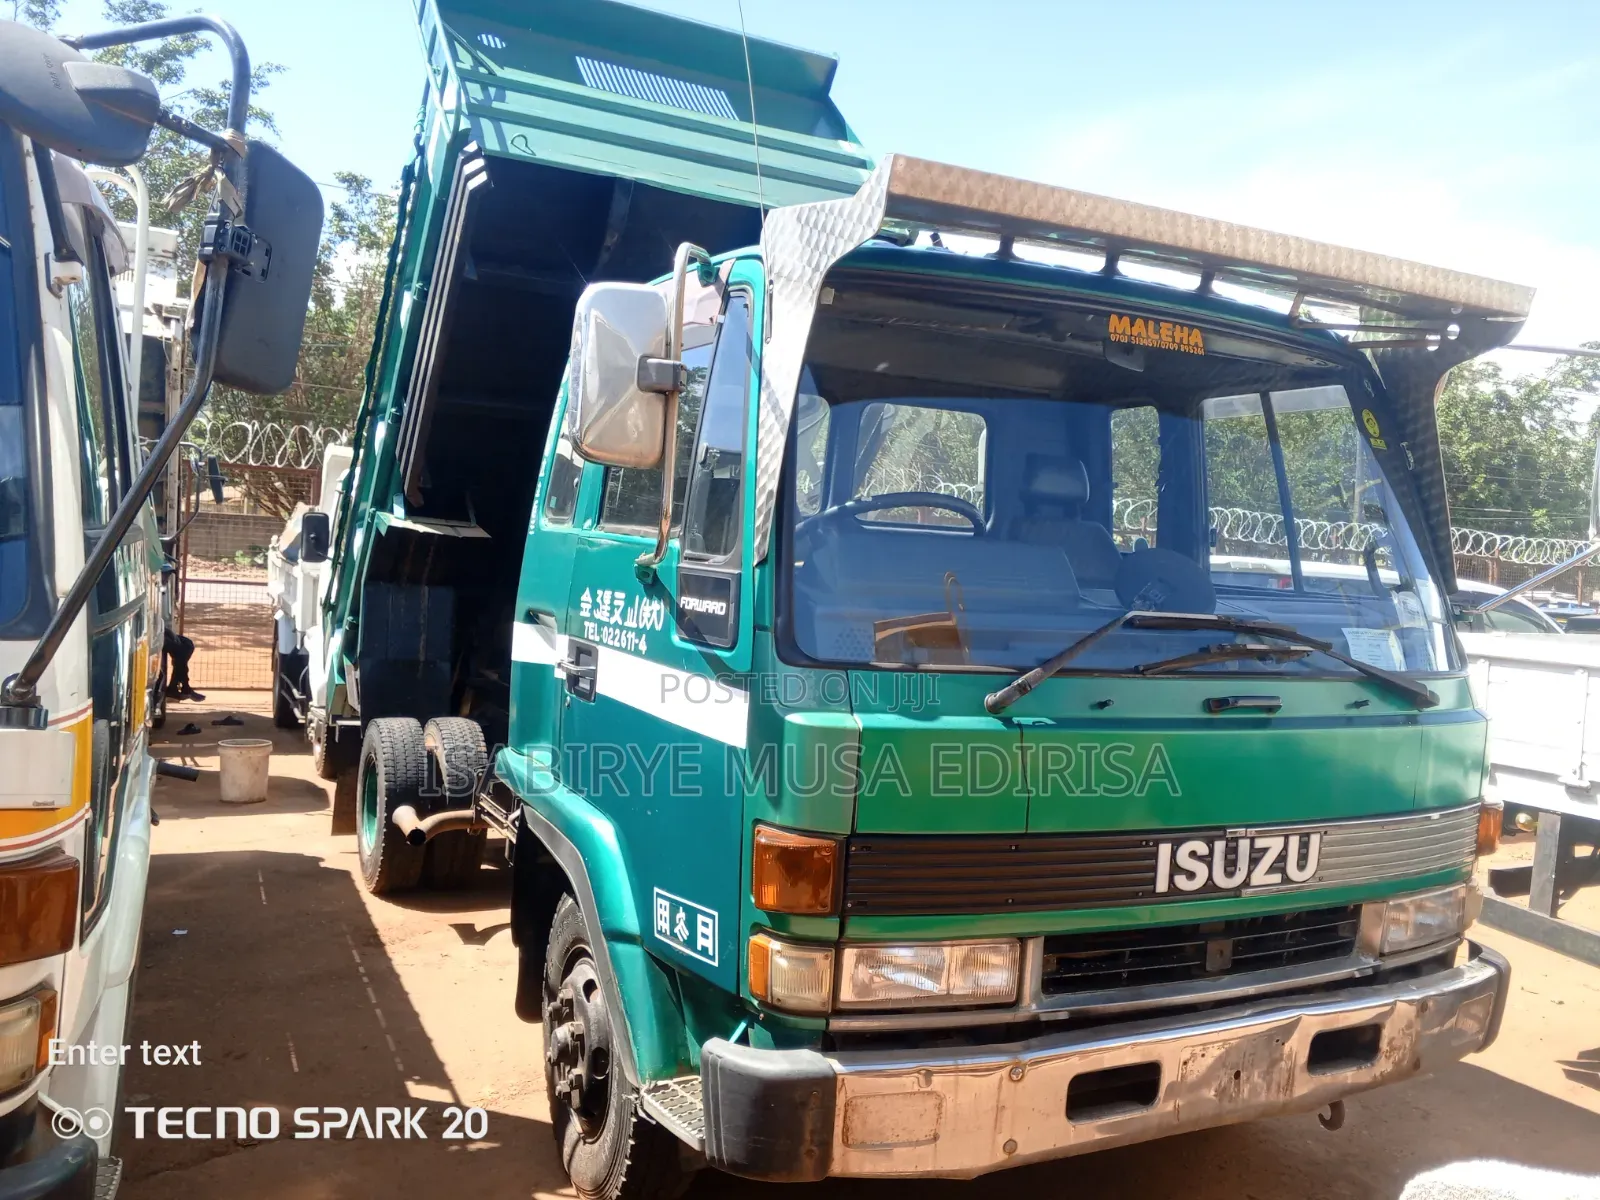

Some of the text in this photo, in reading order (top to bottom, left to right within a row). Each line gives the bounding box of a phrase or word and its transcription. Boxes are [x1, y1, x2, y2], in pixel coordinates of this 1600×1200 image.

[1108, 313, 1204, 348] MALEHA
[679, 596, 726, 616] FORWARD
[1155, 832, 1322, 893] ISUZU
